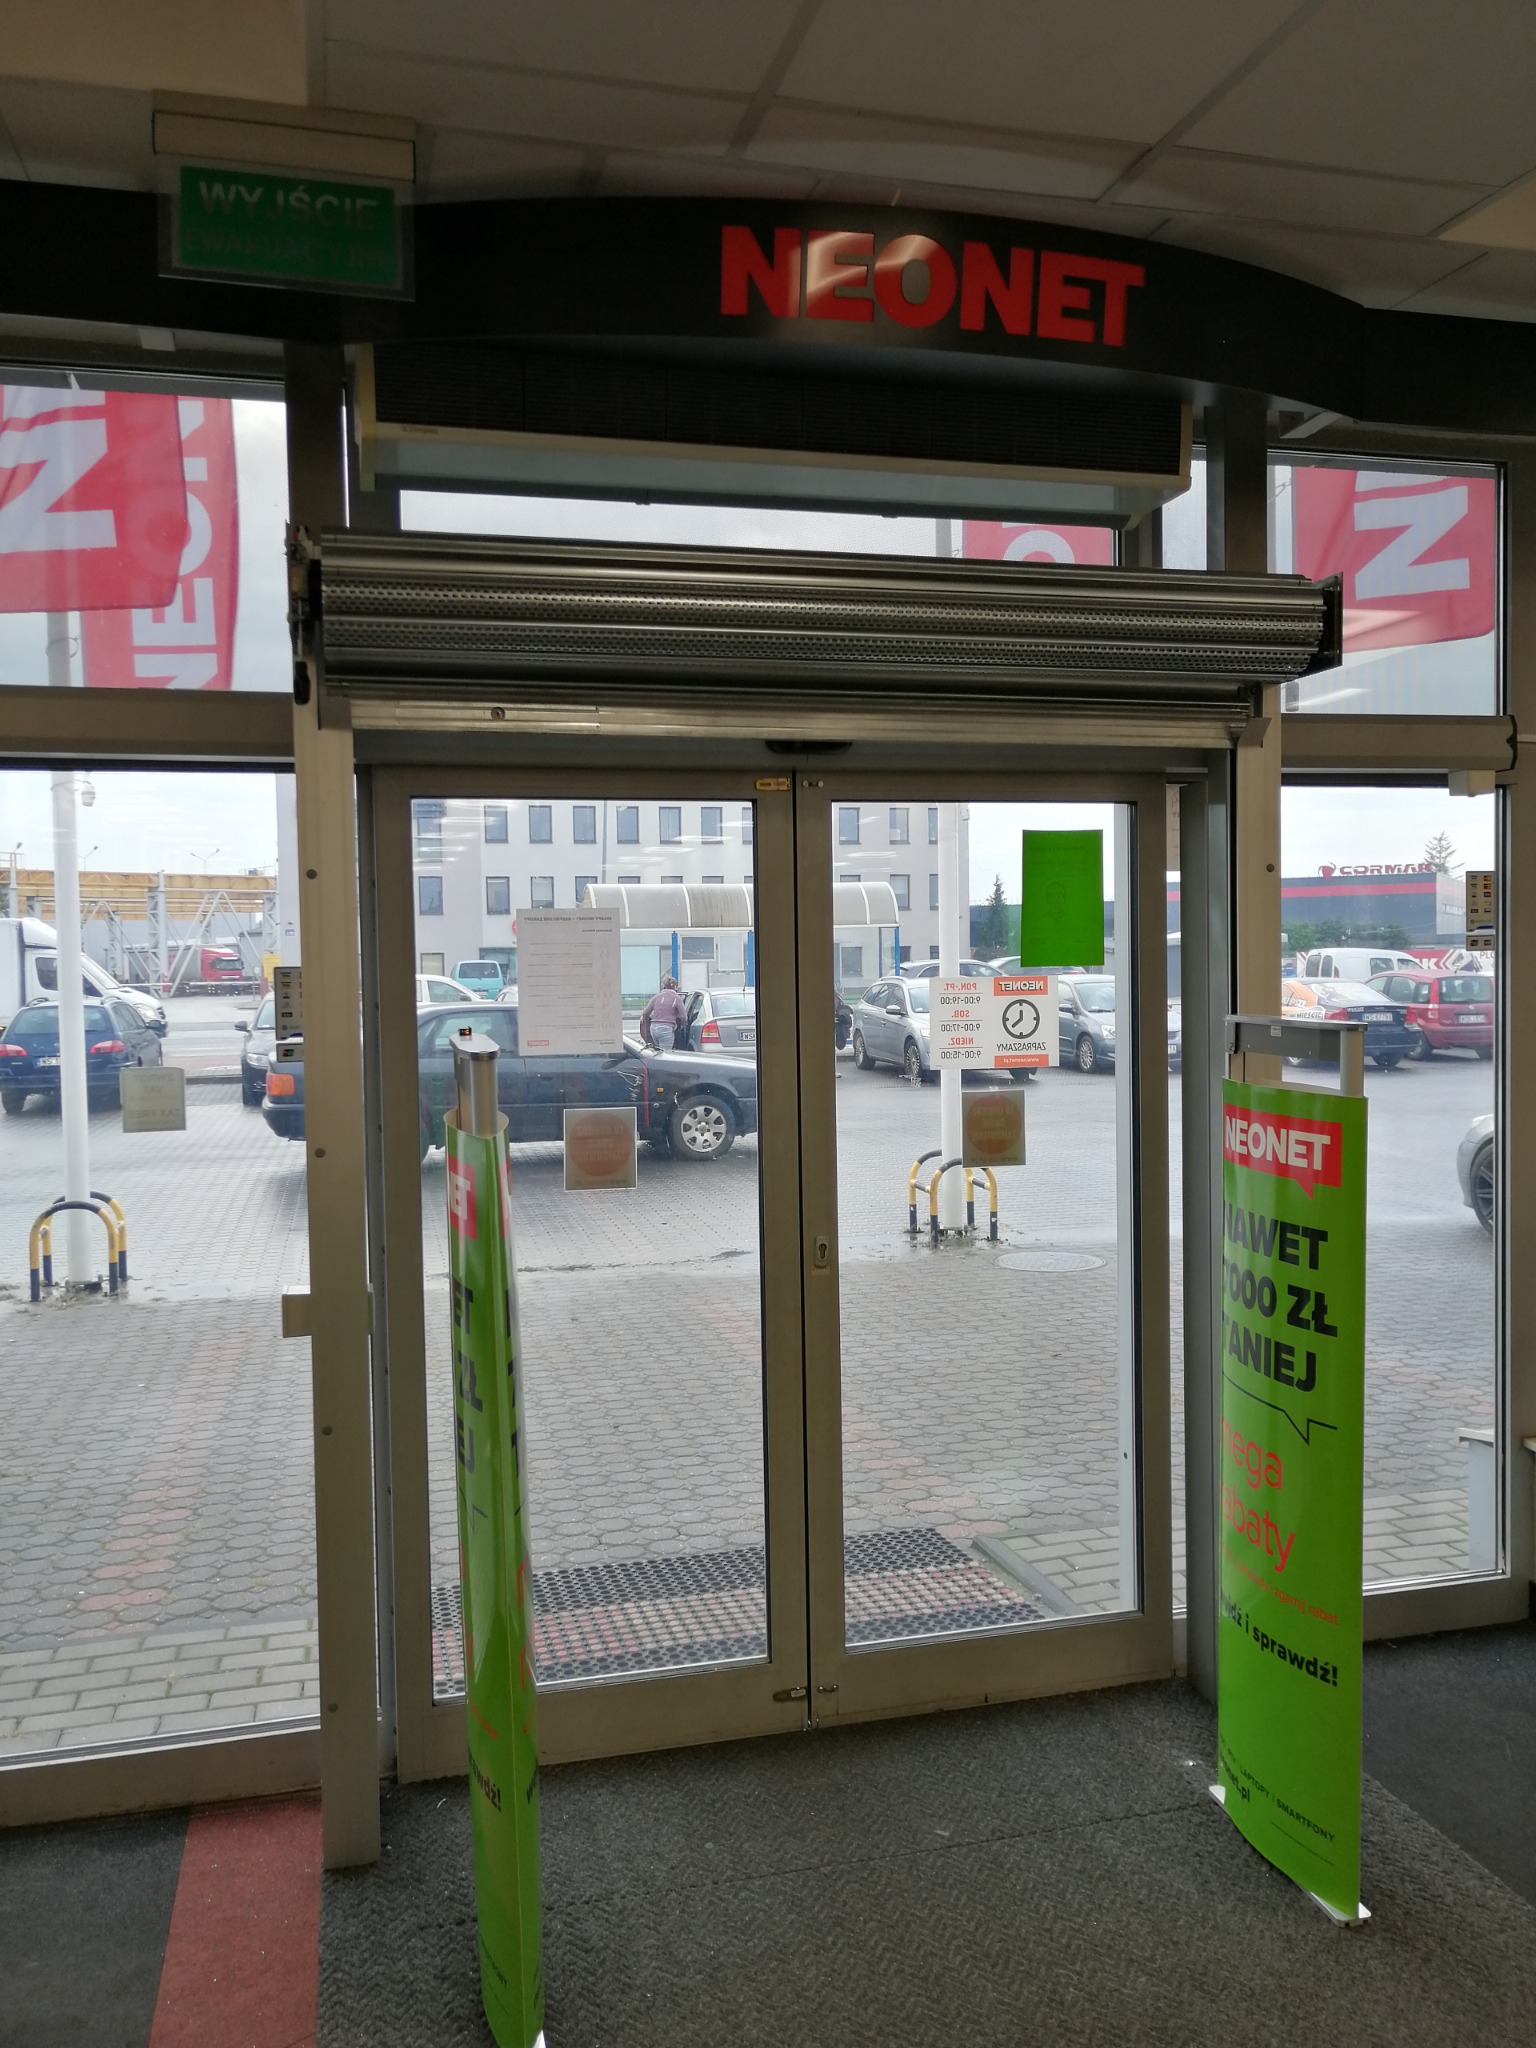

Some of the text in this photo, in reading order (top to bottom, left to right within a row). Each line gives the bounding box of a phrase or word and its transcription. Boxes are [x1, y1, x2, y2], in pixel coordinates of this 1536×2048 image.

[199, 181, 377, 230] WYJŚCIE
[721, 225, 1146, 348] NEONET
[1225, 1115, 1331, 1171] NEONET
[1287, 1284, 1338, 1338] ZŁ
[1308, 1605, 1339, 1626] rabat
[1245, 1613, 1249, 1634] i
[1253, 1626, 1338, 1687] sprawdź!
[1277, 1798, 1335, 1842] SMARTFONY
